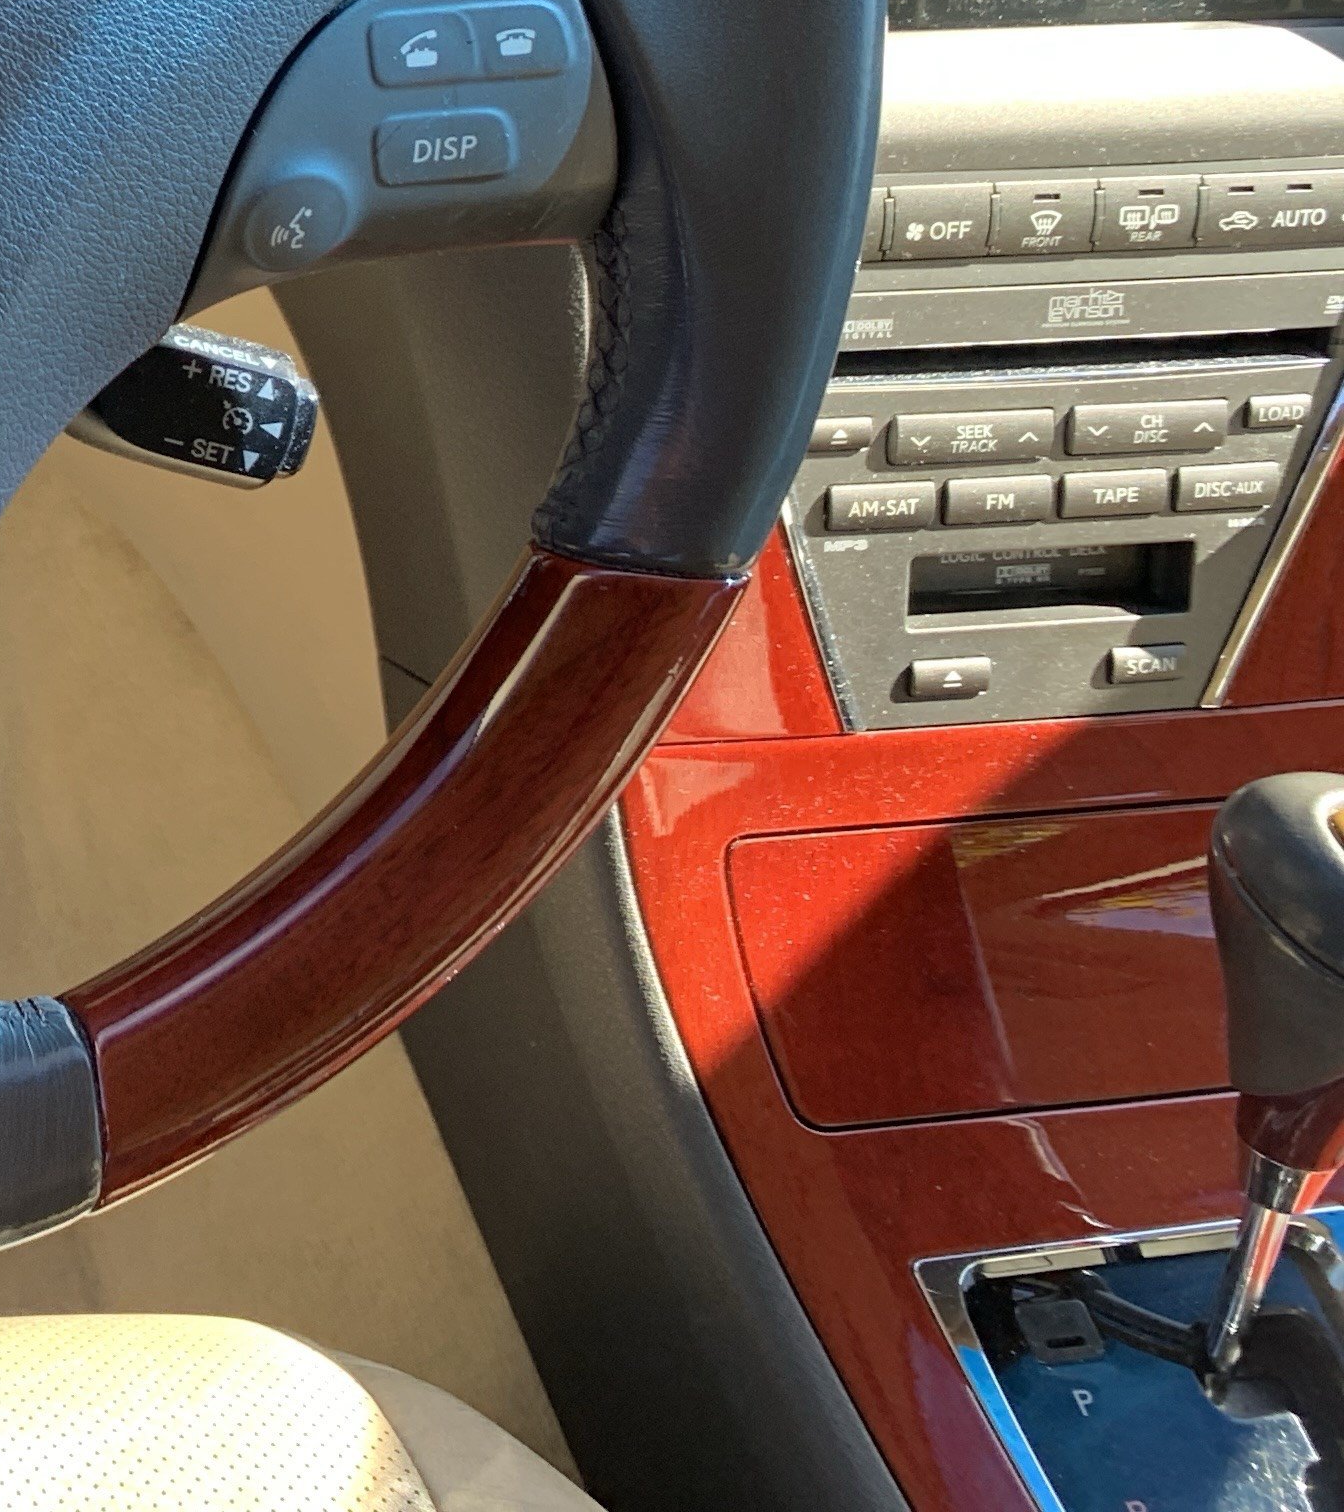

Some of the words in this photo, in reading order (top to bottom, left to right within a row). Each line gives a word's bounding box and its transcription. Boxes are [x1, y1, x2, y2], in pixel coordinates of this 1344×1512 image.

[412, 134, 478, 164] DISP
[1271, 207, 1328, 228] AUTO
[929, 220, 973, 240] OFF
[1128, 230, 1162, 243] REAR
[1021, 235, 1063, 248] FRONT
[857, 320, 893, 331] DOLBY
[844, 331, 893, 340] IGITAL
[174, 335, 260, 367] CANCEL
[208, 364, 253, 394] RES
[1140, 414, 1164, 429] CH
[1258, 405, 1305, 423] LOAD
[955, 424, 994, 440] SEEK
[1133, 429, 1169, 444] DISC
[190, 437, 235, 465] SET
[950, 439, 998, 454] TRACK
[985, 493, 1015, 510] FM
[1093, 487, 1140, 505] TAPE
[823, 539, 869, 552] MP3
[1126, 655, 1178, 677] SCAN
[1072, 1389, 1094, 1417] P
